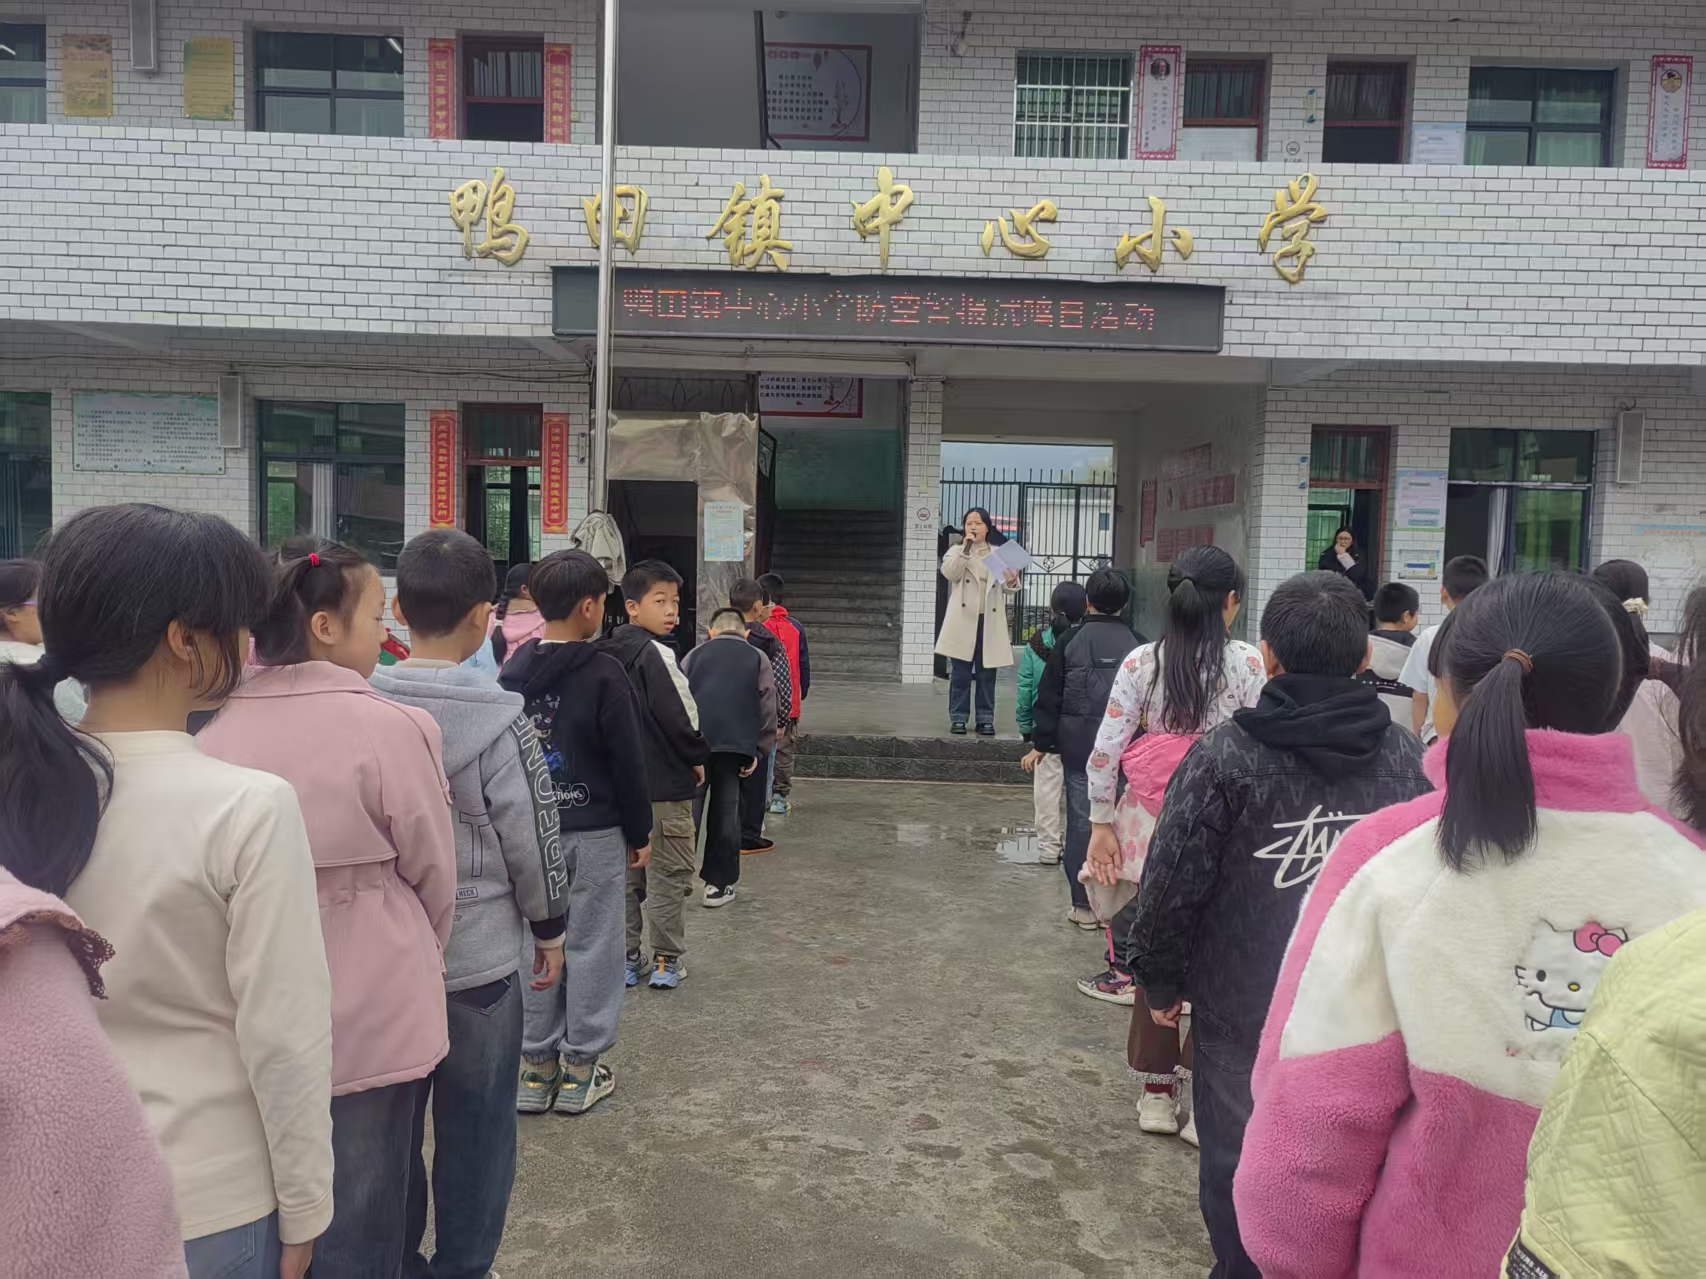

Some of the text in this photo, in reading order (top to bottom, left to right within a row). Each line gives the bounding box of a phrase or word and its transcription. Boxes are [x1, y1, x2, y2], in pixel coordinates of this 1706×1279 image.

[449, 166, 1329, 284] 鸭田镇中心小学
